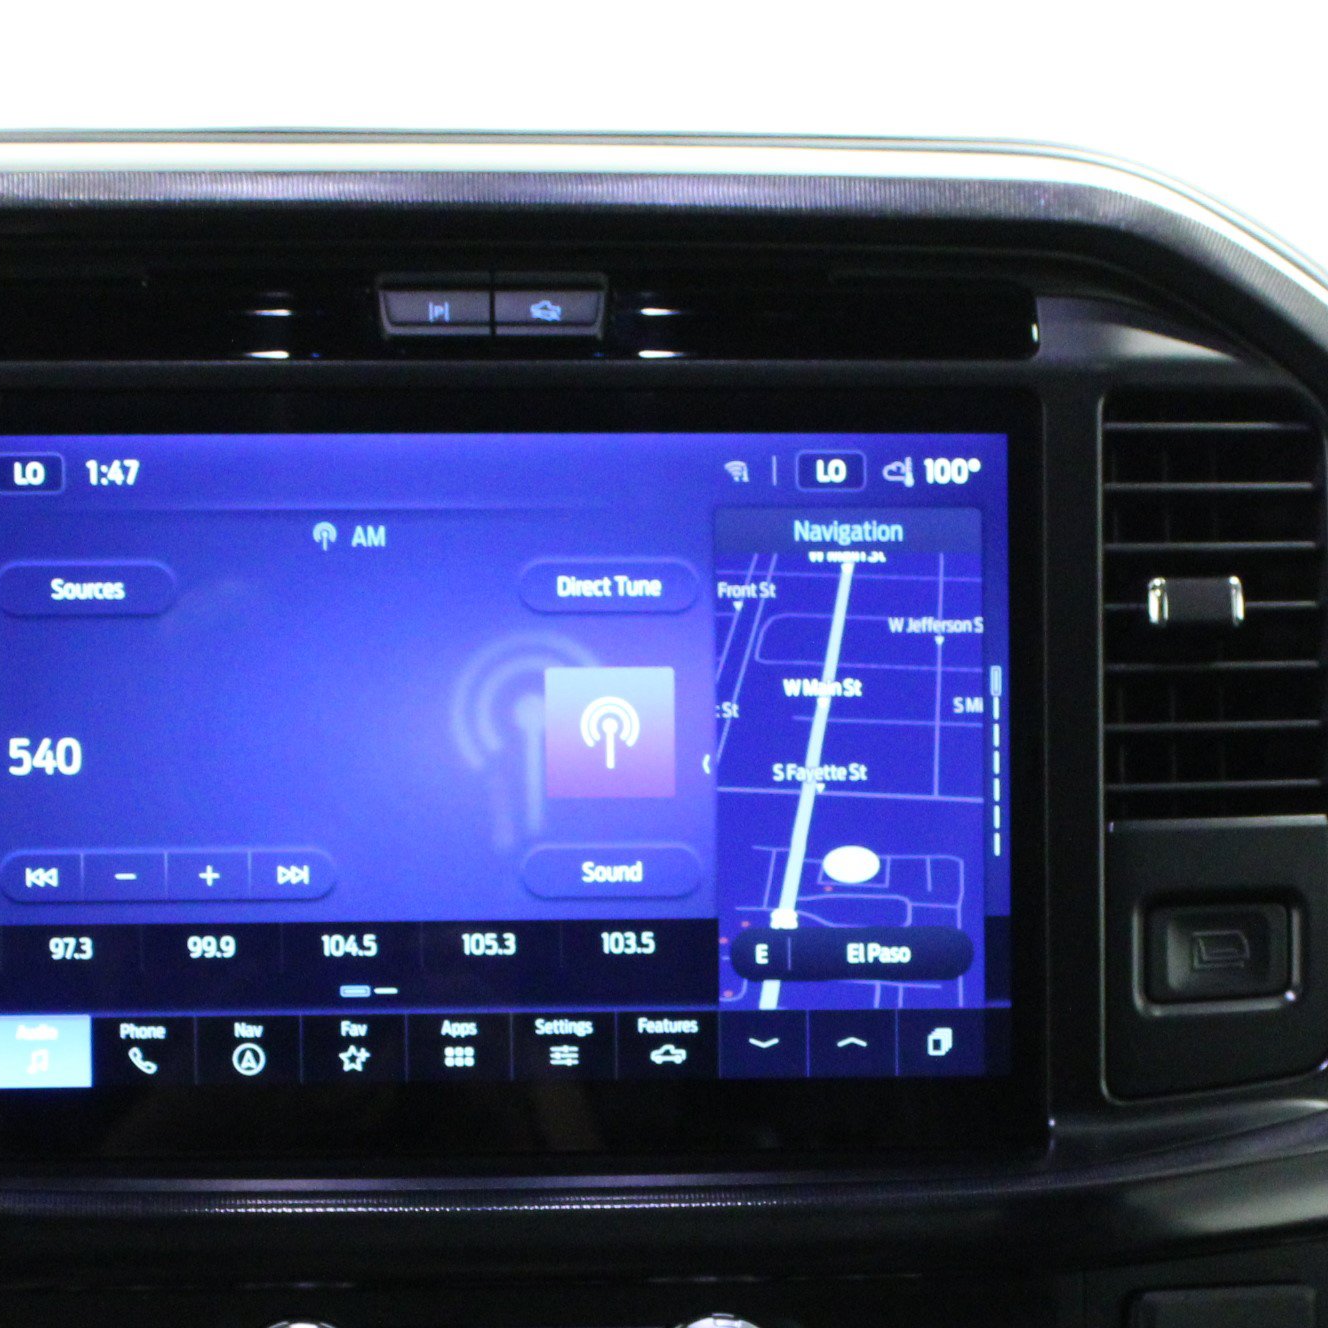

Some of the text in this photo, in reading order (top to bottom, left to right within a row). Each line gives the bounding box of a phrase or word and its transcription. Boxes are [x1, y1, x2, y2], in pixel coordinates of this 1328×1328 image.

[13, 460, 46, 486] LO
[85, 459, 140, 486] 1:47
[815, 459, 847, 483] LO
[351, 526, 386, 547] AM
[794, 520, 903, 546] Navigation
[50, 578, 125, 602] Sources
[556, 575, 662, 599] Direct Tune
[717, 581, 776, 598] Front St
[888, 617, 903, 633] W
[906, 616, 971, 633] Jefferson
[783, 678, 863, 697] W Main St
[953, 698, 964, 713] S
[8, 737, 82, 776] 540
[772, 763, 868, 785] S Fayette St
[582, 860, 643, 883] Sound
[49, 936, 93, 960] 97.3
[187, 935, 236, 958] 99.9
[321, 934, 377, 957] 104.5
[462, 933, 516, 956] 105.3
[601, 931, 656, 954] 103.5
[755, 943, 768, 964] E
[847, 942, 912, 963] El Paso
[120, 1023, 166, 1039] Phone
[234, 1022, 263, 1038] Nav
[340, 1021, 367, 1037] Fav
[441, 1020, 477, 1038] Apps
[535, 1018, 593, 1036] Settings
[637, 1017, 698, 1033] Features
